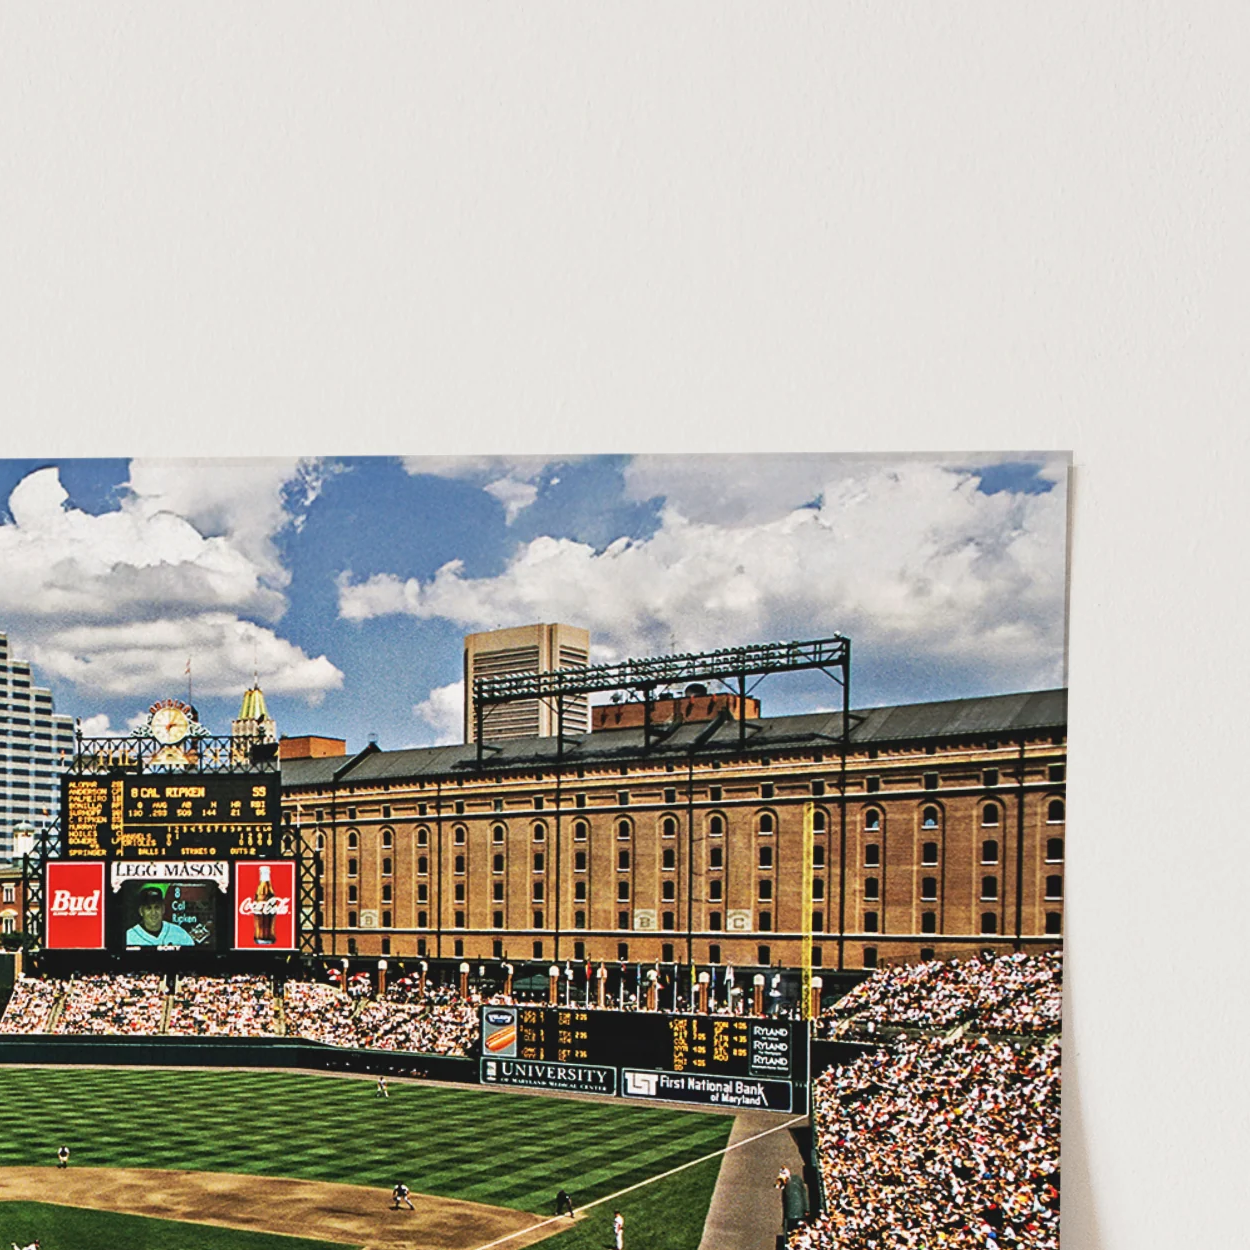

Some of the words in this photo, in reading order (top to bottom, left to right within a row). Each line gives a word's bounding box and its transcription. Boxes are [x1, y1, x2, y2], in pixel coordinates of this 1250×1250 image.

[131, 787, 139, 798] 8
[140, 787, 161, 798] CAL
[165, 786, 206, 798] RIPKEN
[252, 786, 267, 797] SS
[116, 862, 157, 877] LEGG
[164, 863, 224, 877] MASON
[174, 886, 181, 899] 8
[50, 889, 102, 912] Bud
[171, 900, 186, 911] Cal
[171, 913, 197, 926] Ripken
[639, 916, 650, 928] B
[733, 917, 745, 929] C
[753, 1025, 789, 1036] RYLAND
[753, 1040, 789, 1051] RYLAND
[753, 1054, 789, 1066] RYLAND
[502, 1062, 607, 1083] UNIVERSITY
[579, 1084, 607, 1092] CENTER
[660, 1075, 685, 1090] First
[688, 1077, 732, 1093] National
[735, 1081, 766, 1097] Bank
[710, 1093, 719, 1102] of
[721, 1094, 761, 1107] Maryland
